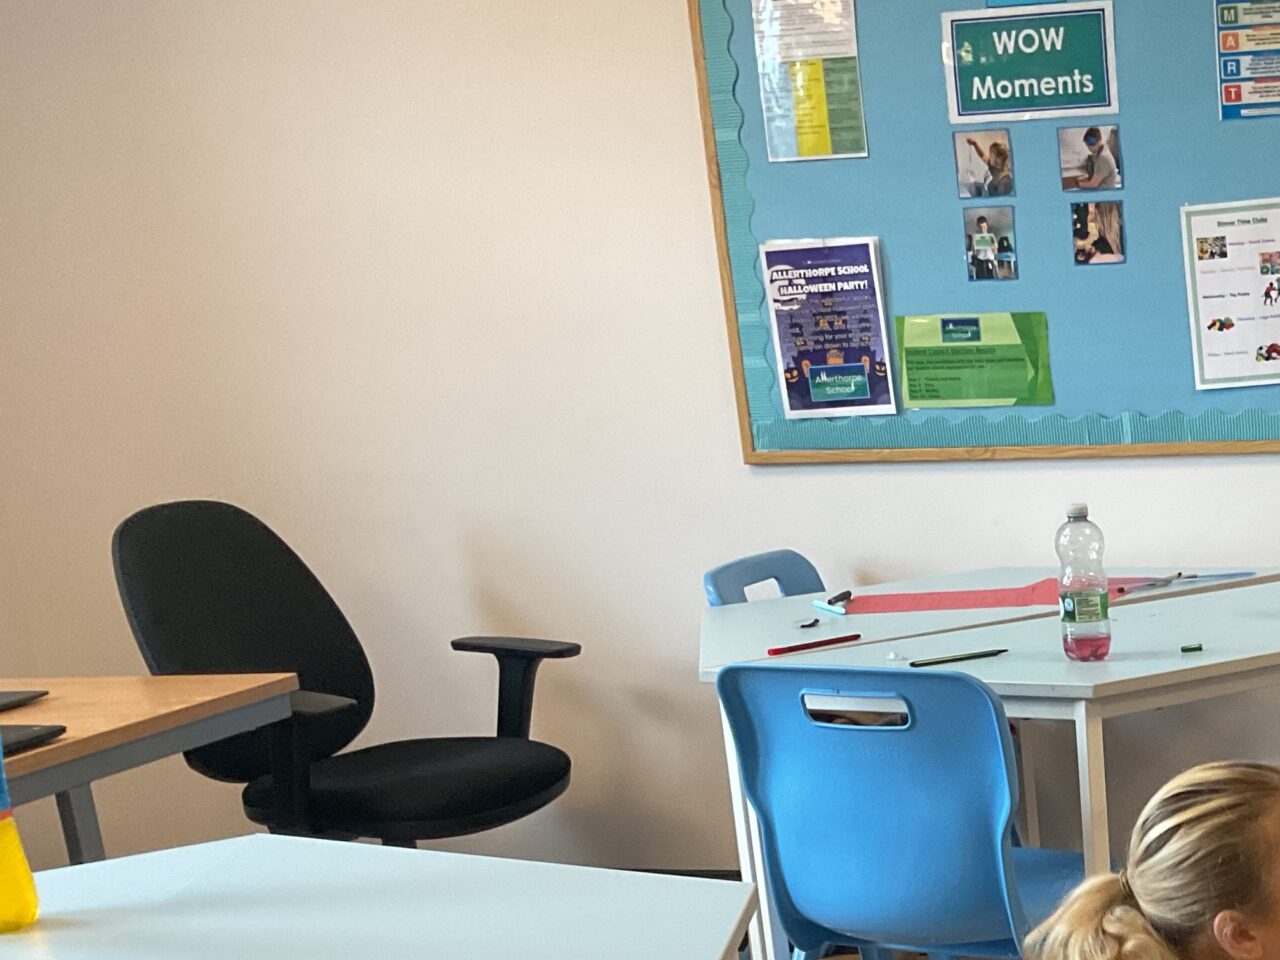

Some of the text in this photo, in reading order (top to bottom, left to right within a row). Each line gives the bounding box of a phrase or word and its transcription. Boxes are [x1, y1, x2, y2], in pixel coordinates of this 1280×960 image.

[1223, 9, 1235, 22] M
[992, 26, 1064, 55] WOW
[1226, 36, 1236, 48] A
[1227, 61, 1237, 74] R
[972, 69, 1094, 100] Moments
[1228, 88, 1238, 100] T
[772, 264, 869, 280] ALLERTHORPE SCHOOL
[780, 280, 868, 295] HALLOWEEN PARTY!
[815, 371, 863, 383] Allerthorpe
[825, 381, 855, 394] School
